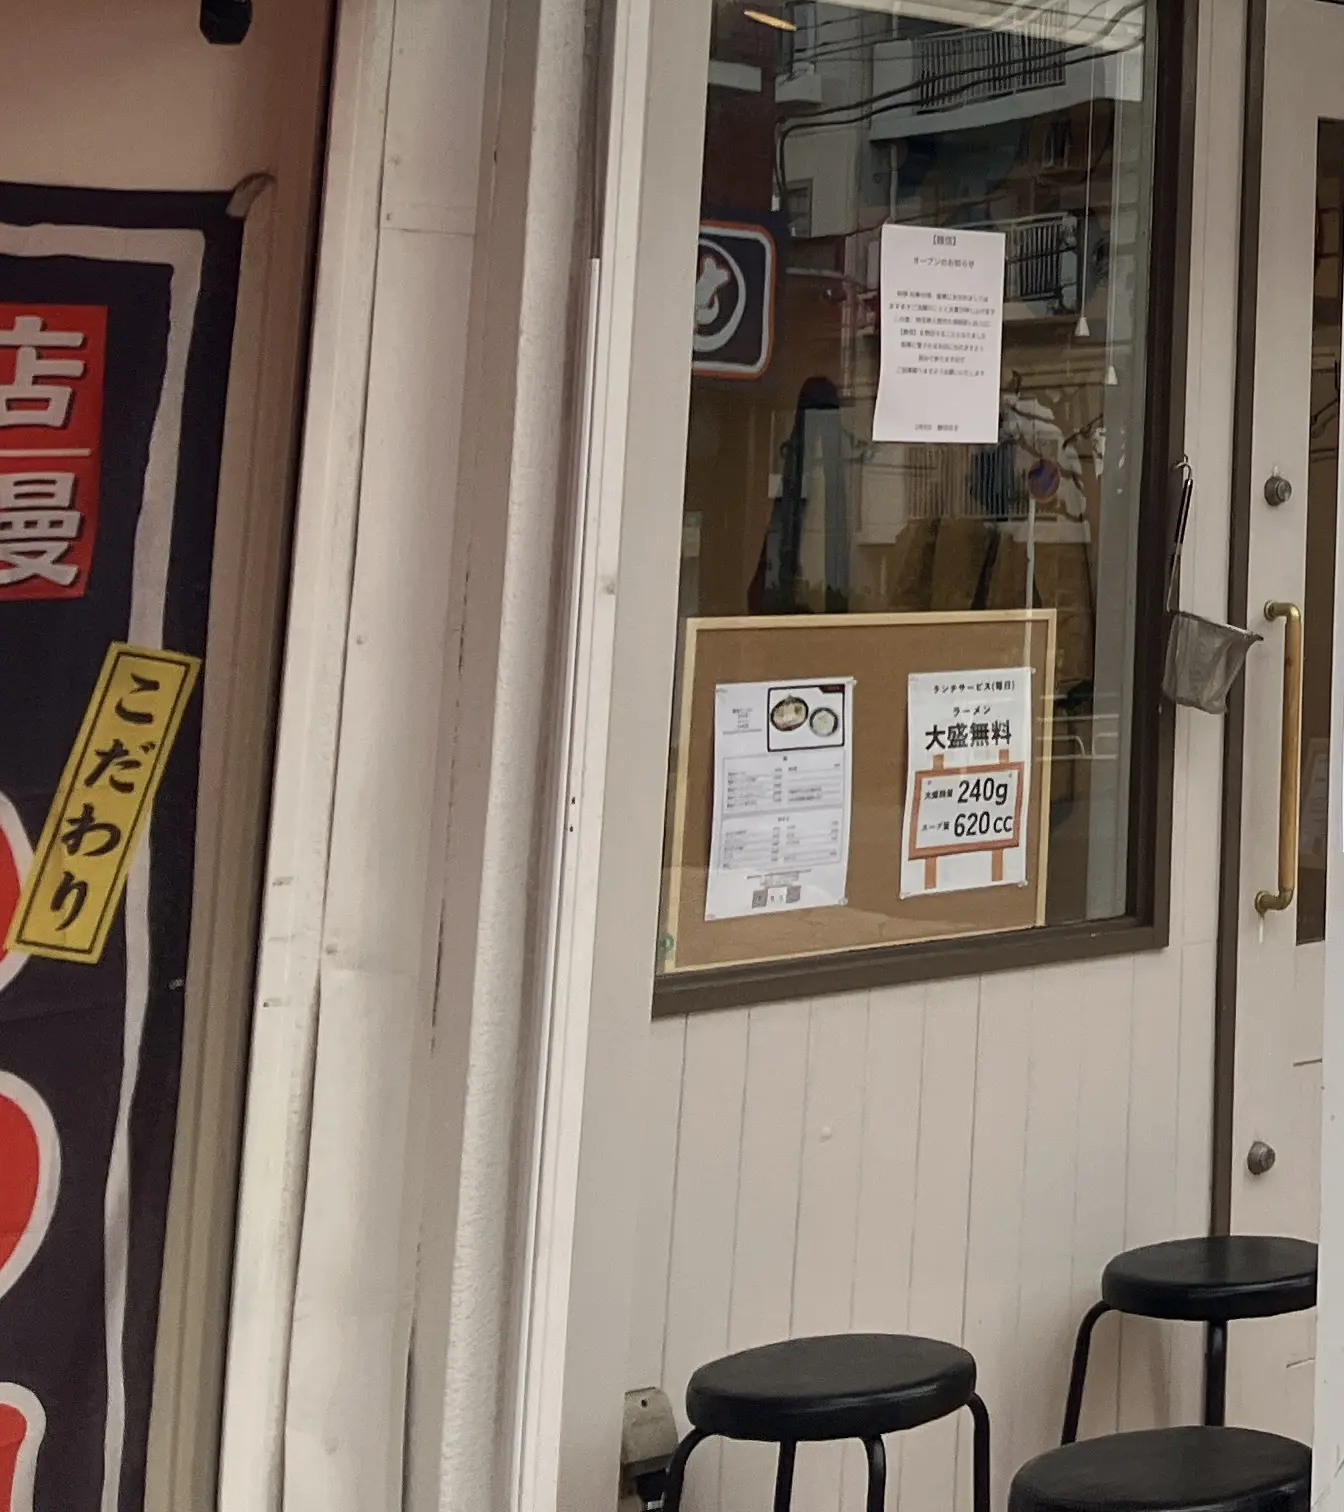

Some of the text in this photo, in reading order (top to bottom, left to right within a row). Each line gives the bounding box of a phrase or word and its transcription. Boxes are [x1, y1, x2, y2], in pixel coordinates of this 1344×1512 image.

[952, 705, 992, 717] ラーメン
[924, 719, 1012, 750] 大盛無料
[50, 671, 160, 931] こだわり
[957, 777, 1008, 806] 240g
